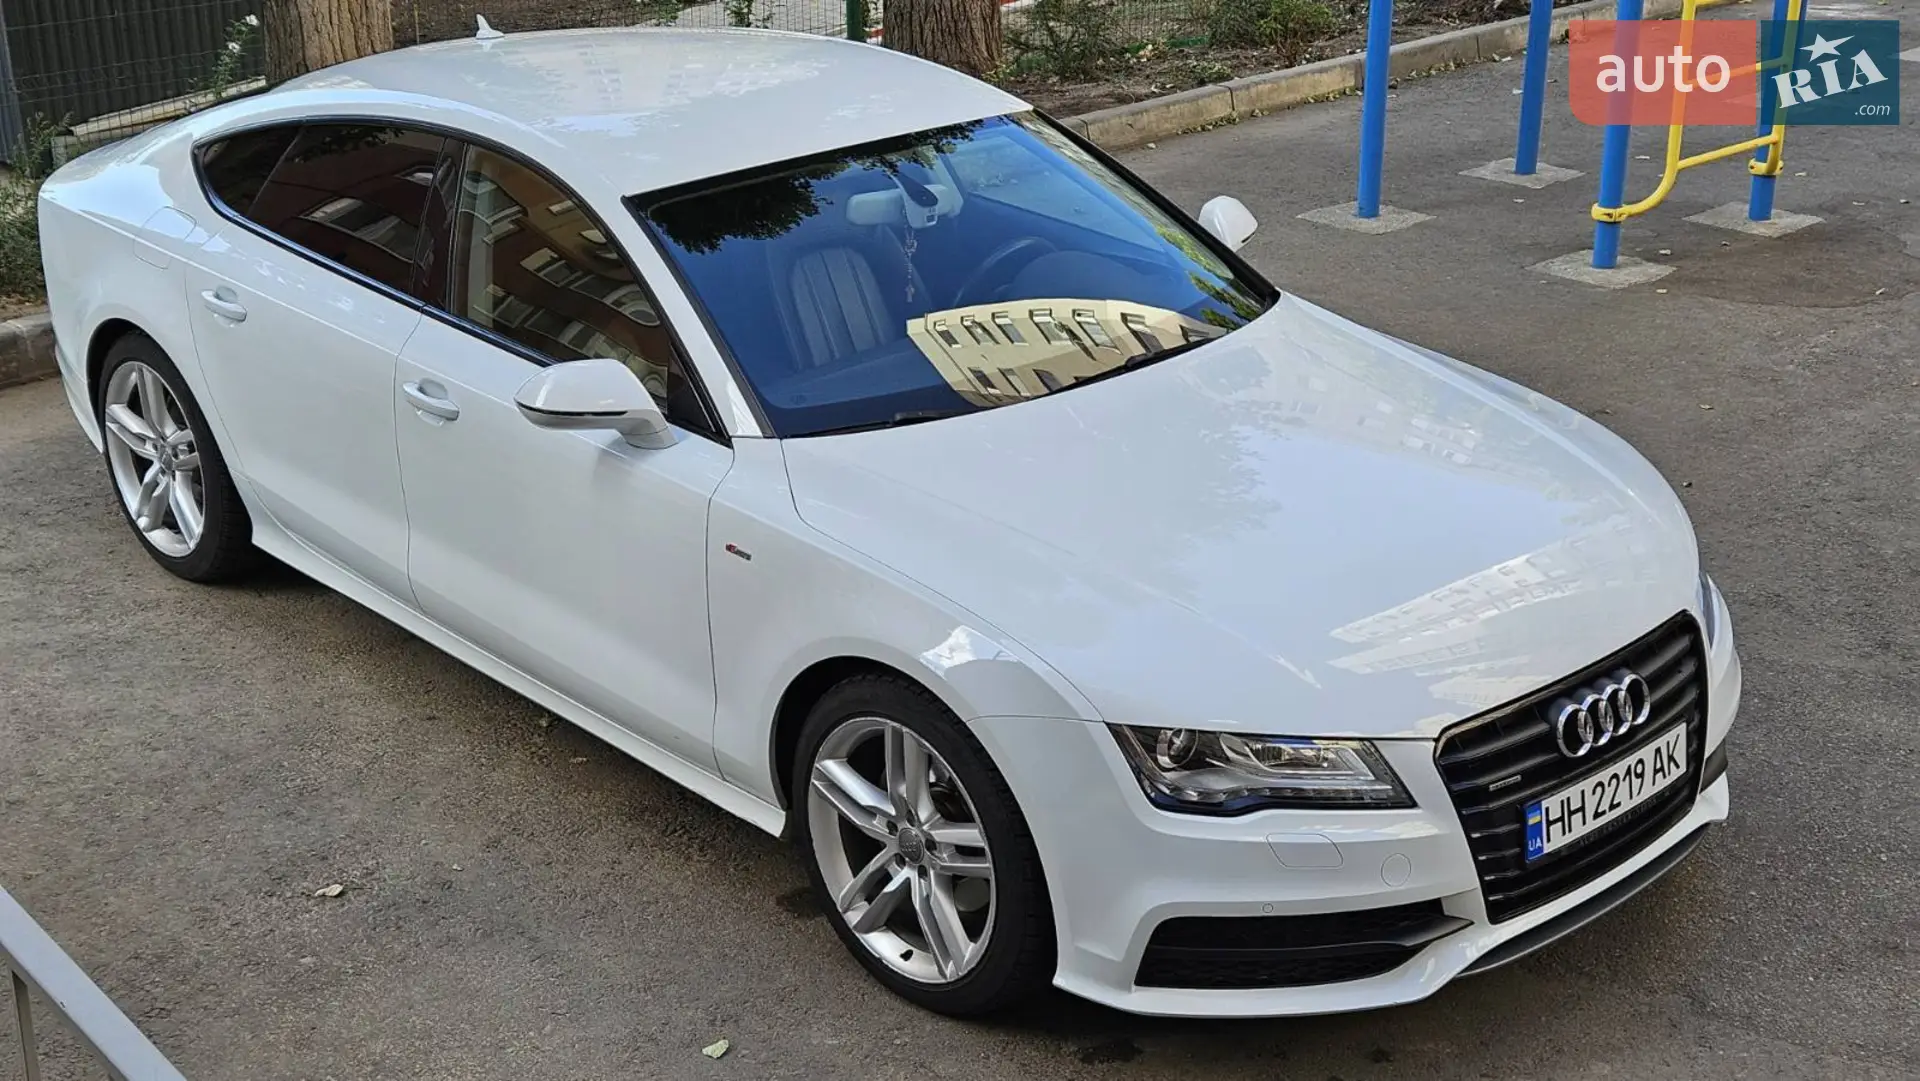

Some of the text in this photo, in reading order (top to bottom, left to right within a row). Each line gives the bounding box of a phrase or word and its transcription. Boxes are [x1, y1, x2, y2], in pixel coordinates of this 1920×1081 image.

[1545, 789, 1587, 844] HH
[1592, 757, 1646, 821] 2219
[1652, 733, 1681, 787] AK
[1528, 838, 1544, 851] UA
